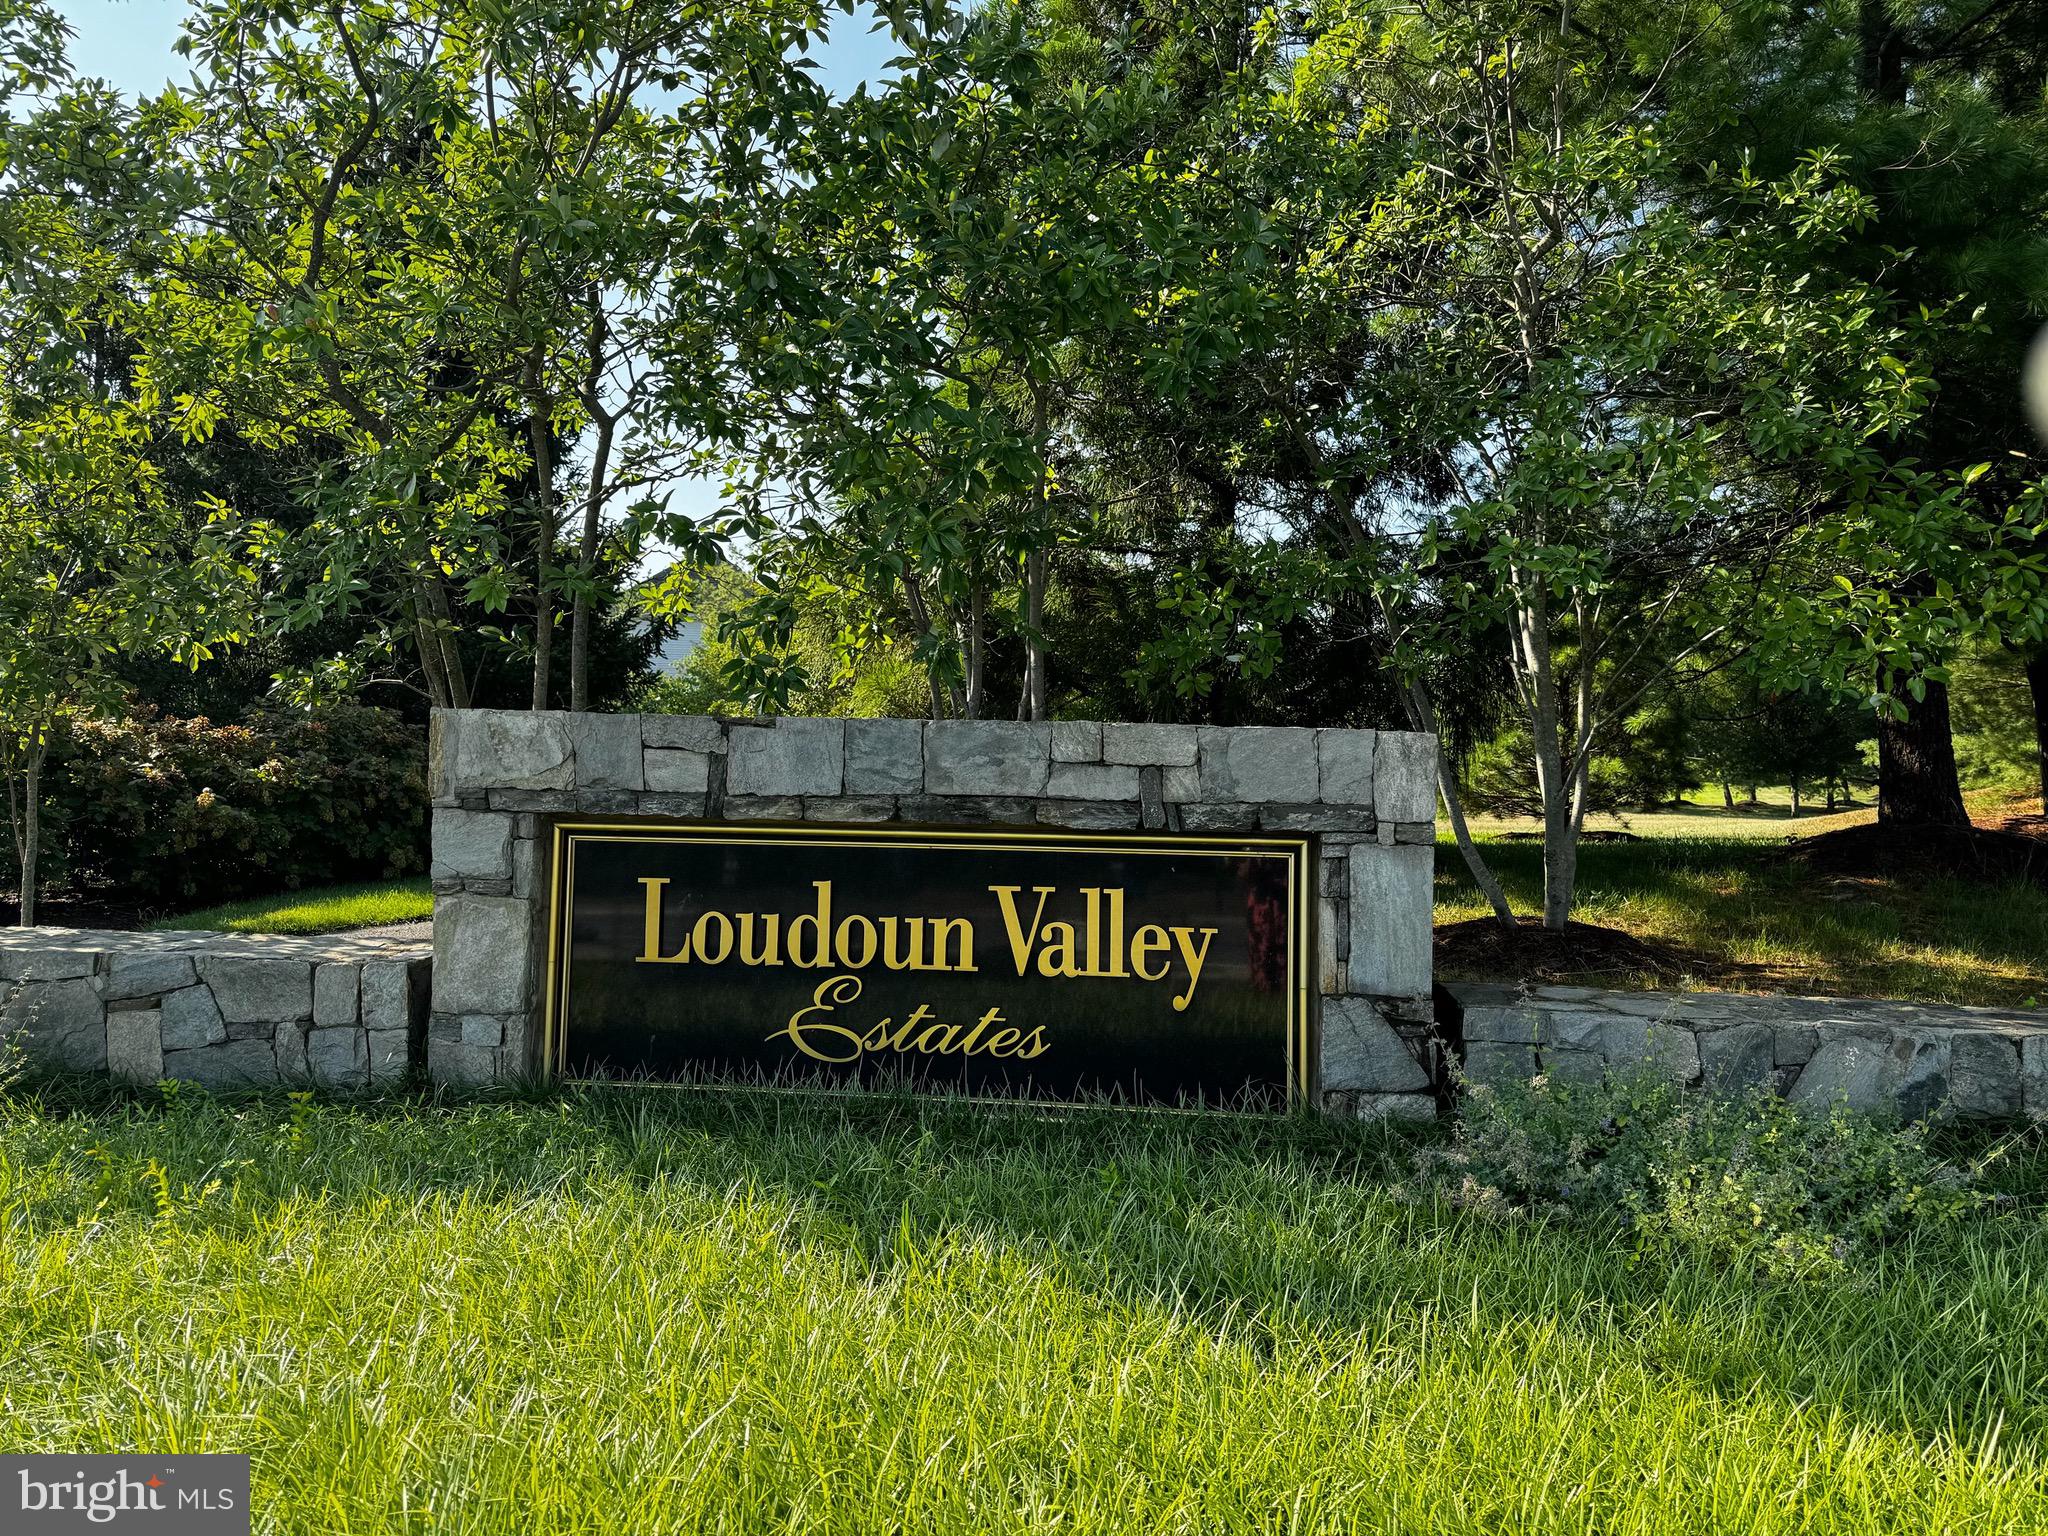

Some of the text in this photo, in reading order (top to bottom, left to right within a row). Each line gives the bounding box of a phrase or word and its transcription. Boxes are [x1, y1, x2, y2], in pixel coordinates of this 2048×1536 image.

[635, 876, 1219, 1012] Loudoun Valley
[764, 974, 1051, 1063] Estates
